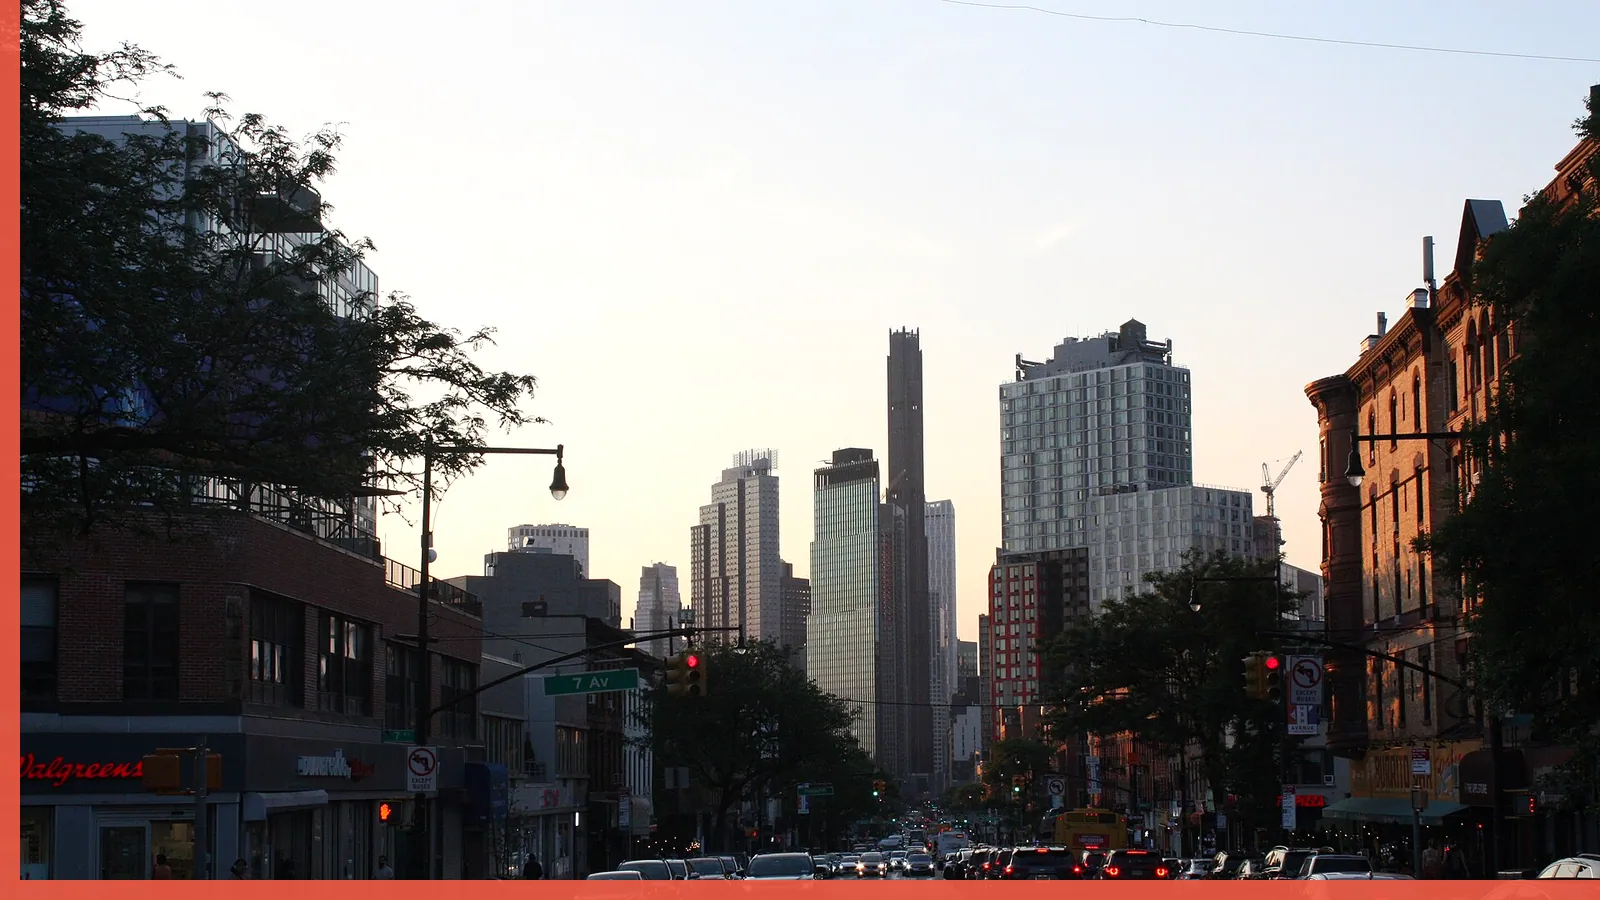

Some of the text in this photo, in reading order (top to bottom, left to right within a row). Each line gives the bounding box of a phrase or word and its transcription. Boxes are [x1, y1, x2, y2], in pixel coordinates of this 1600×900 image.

[572, 675, 609, 690] 7 Av
[393, 731, 400, 741] 7
[20, 752, 145, 788] Walgreens
